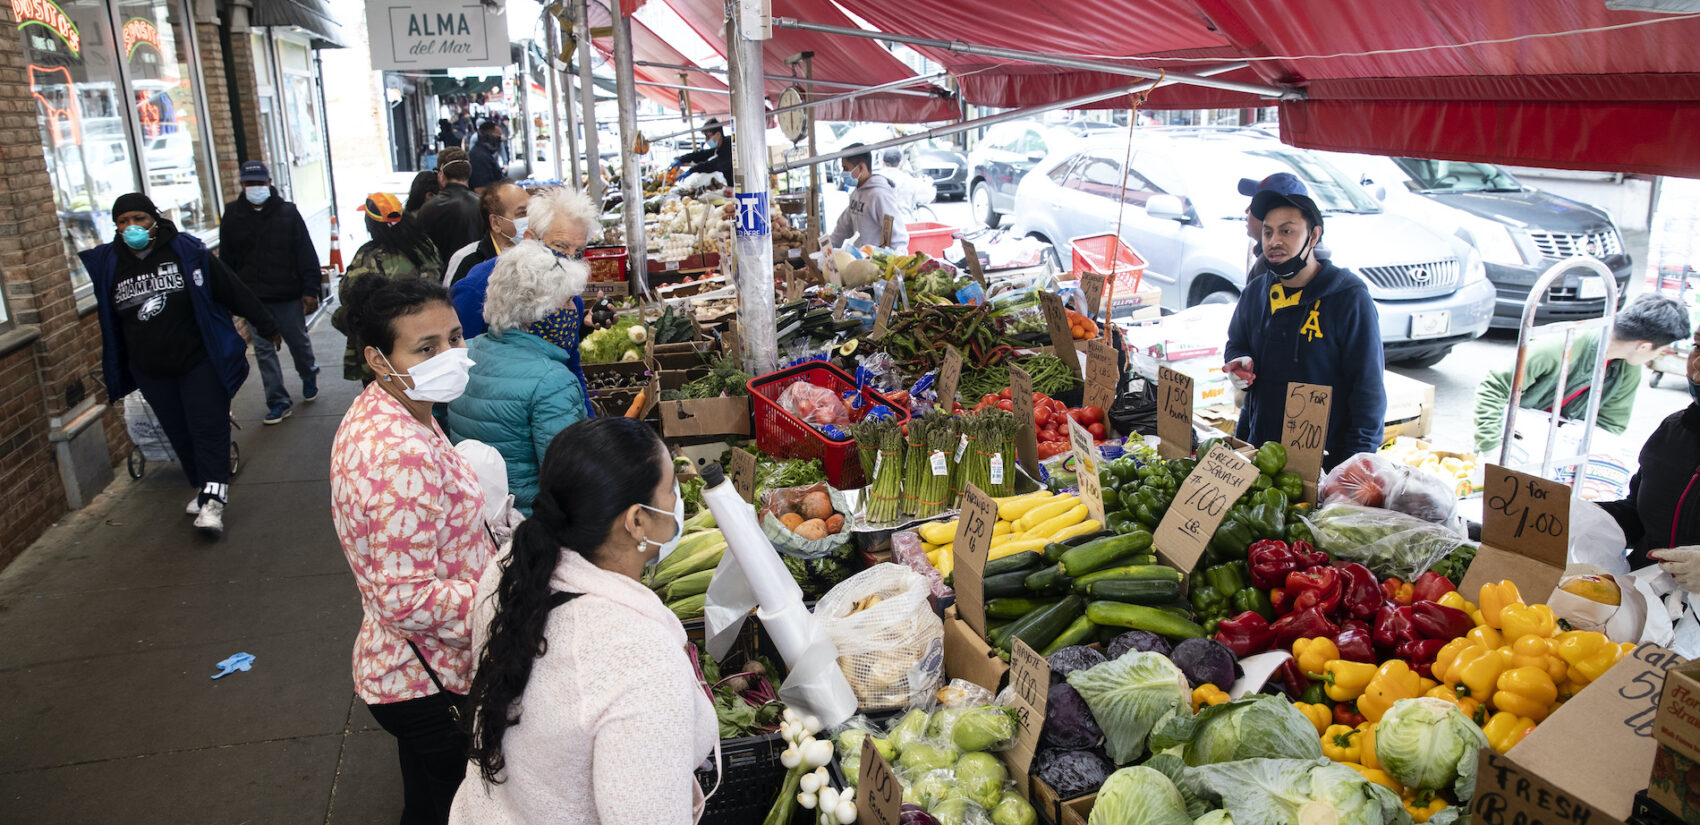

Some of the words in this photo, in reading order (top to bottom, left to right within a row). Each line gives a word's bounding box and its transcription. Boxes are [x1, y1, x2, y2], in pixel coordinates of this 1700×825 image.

[408, 13, 470, 36] ALMA
[409, 40, 434, 55] del
[438, 41, 472, 54] Mar
[115, 274, 185, 303] CHAMPIONS
[1159, 366, 1191, 389] CELERY
[1170, 405, 1190, 424] bunch
[1286, 385, 1305, 418] 5
[1210, 447, 1245, 471] GREEN
[1202, 461, 1244, 488] SQUASH
[1489, 476, 1520, 516] 2
[1526, 481, 1549, 499] for
[964, 510, 984, 538] 1.50
[1514, 506, 1563, 536] 1.00
[1488, 755, 1592, 825] FRESH
